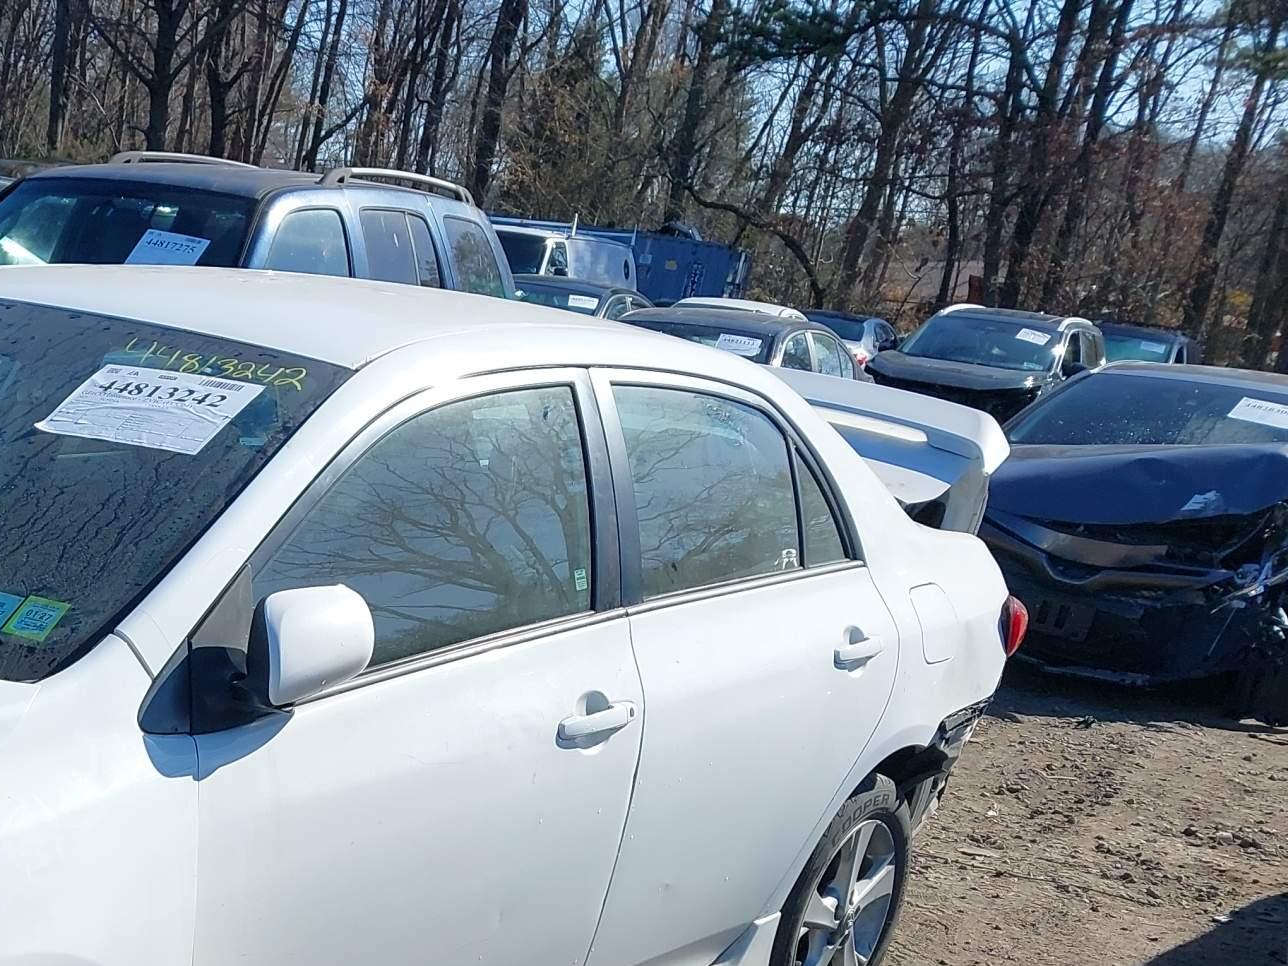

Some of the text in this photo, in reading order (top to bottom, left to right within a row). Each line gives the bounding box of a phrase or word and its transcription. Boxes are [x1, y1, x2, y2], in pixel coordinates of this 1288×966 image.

[145, 238, 197, 254] 44817275
[125, 337, 307, 391] 44813242
[99, 379, 228, 408] 44813242
[831, 793, 890, 848] COOPER
